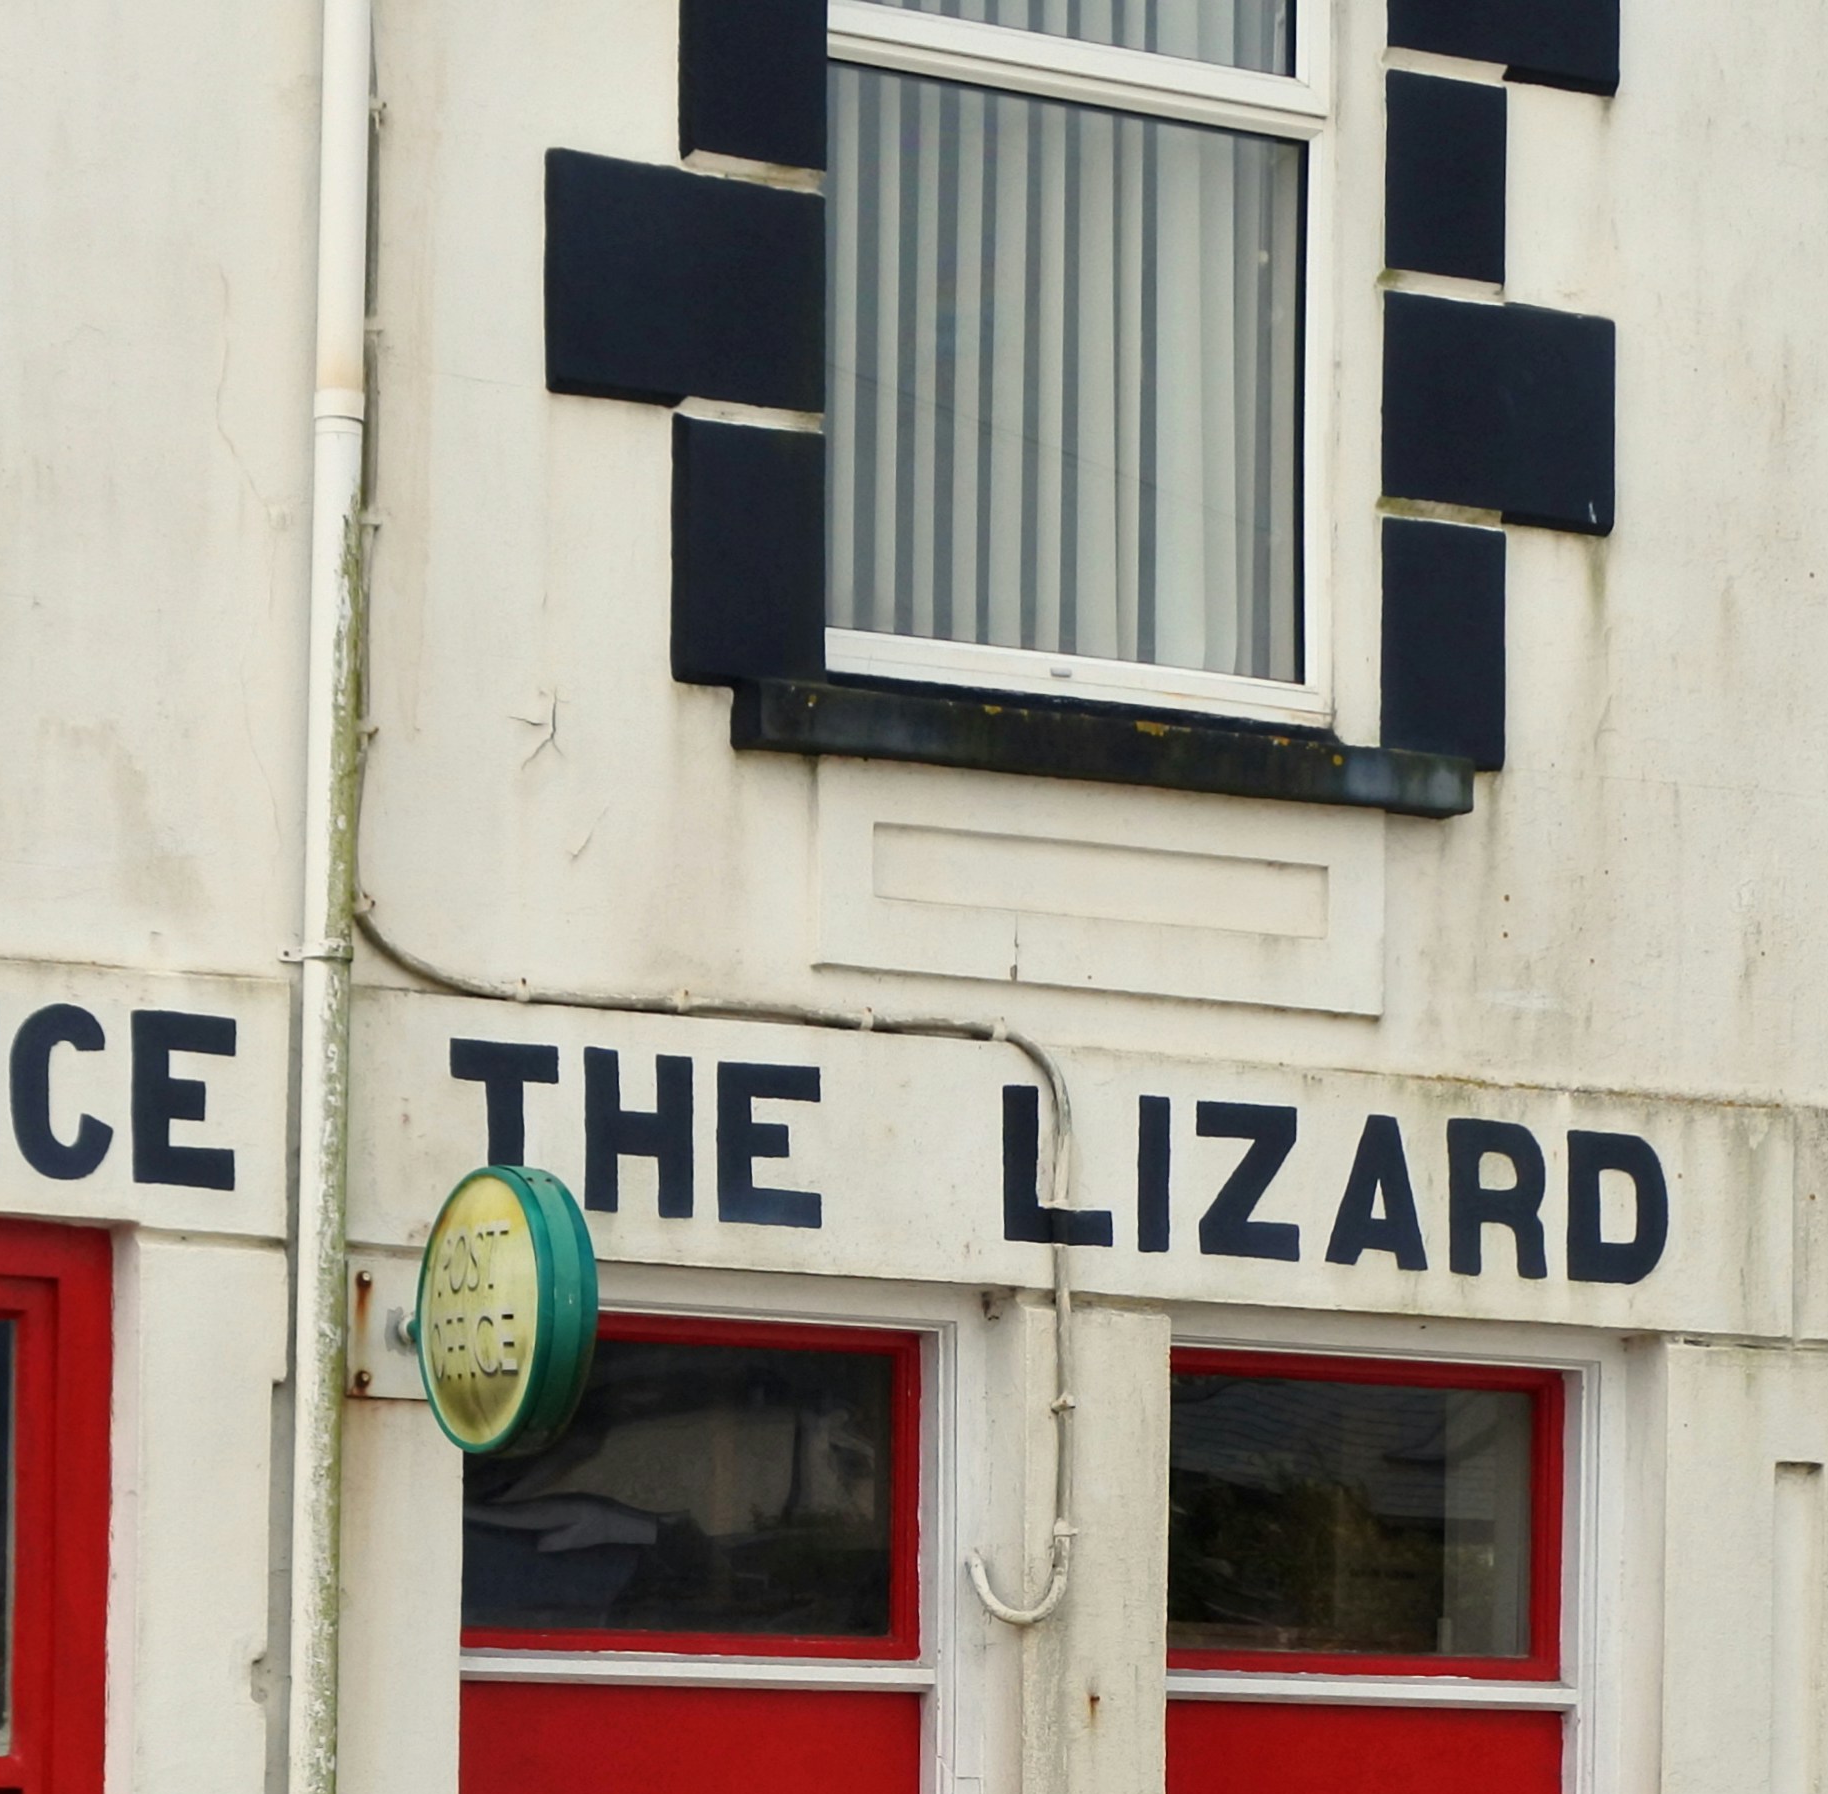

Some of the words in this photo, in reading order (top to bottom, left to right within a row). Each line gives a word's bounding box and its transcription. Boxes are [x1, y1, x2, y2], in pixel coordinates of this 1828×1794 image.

[450, 1038, 822, 1228] THE
[1002, 1084, 1668, 1285] LIZARD
[436, 1219, 510, 1299] POST
[432, 1310, 519, 1383] OFFICE
